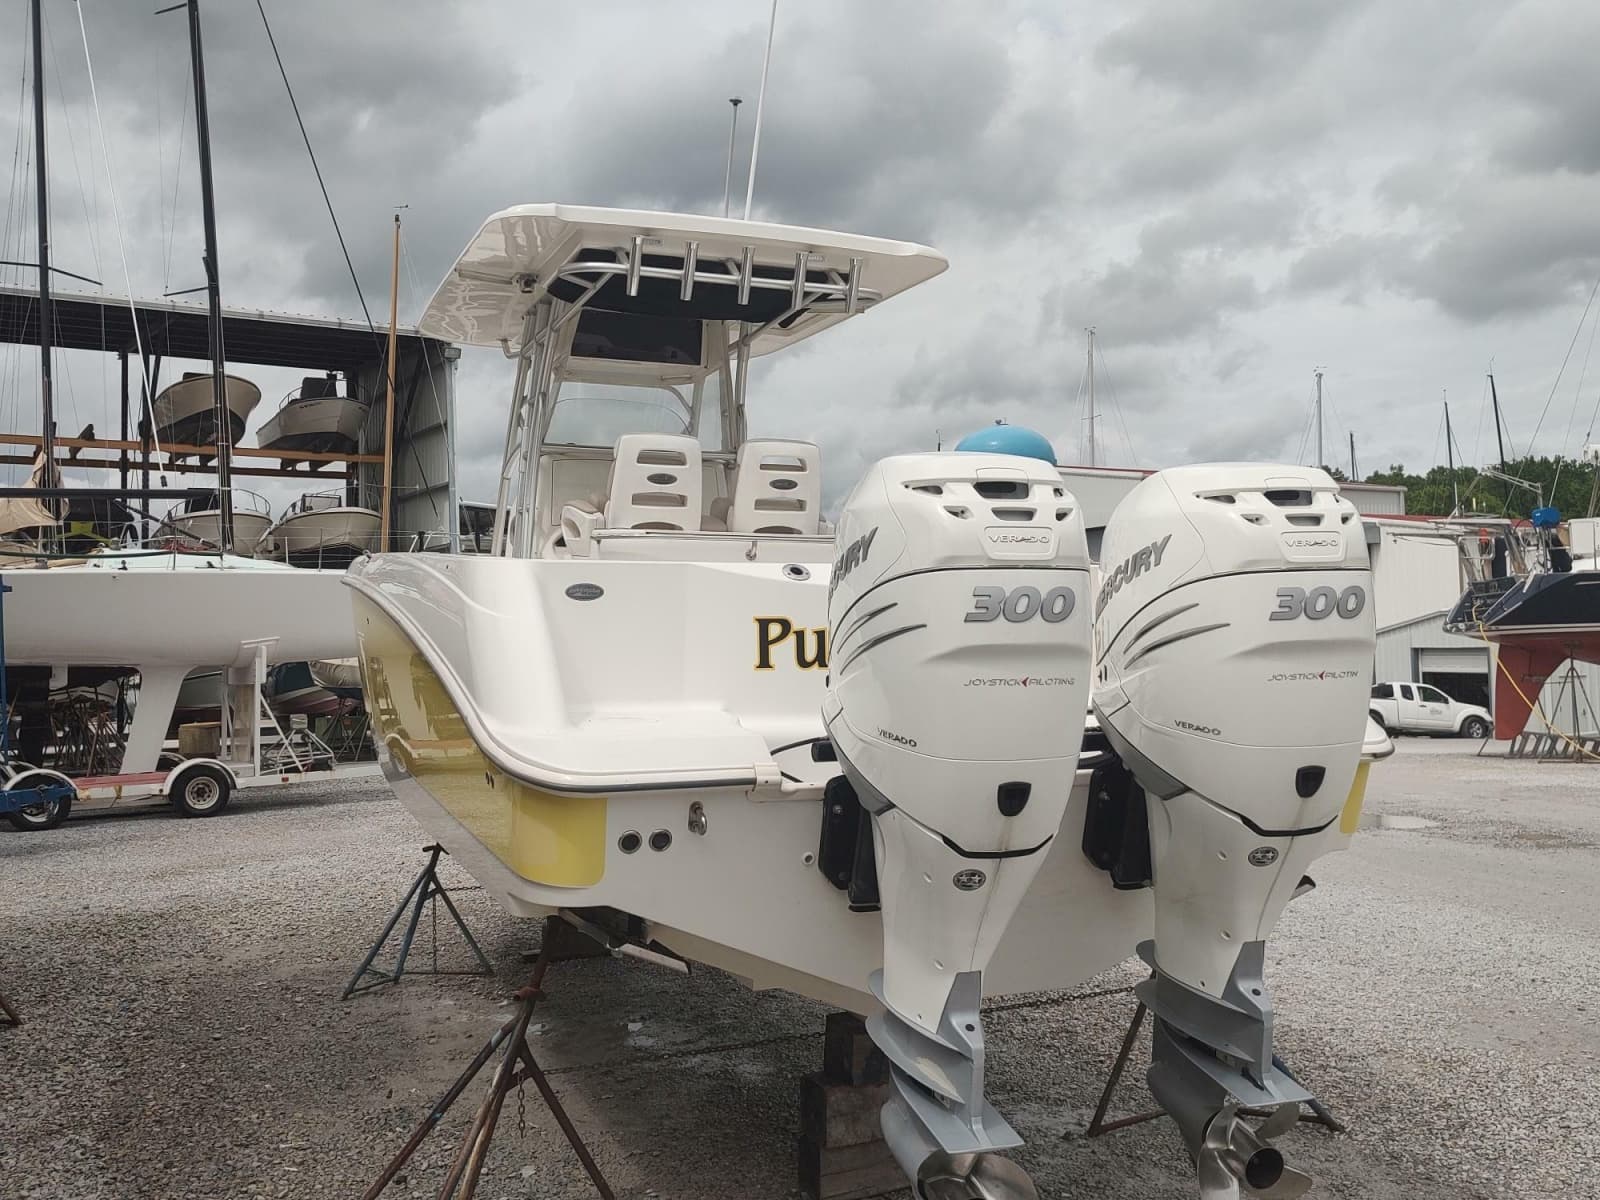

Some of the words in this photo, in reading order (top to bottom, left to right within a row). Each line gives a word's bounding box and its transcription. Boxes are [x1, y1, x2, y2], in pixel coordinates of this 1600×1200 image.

[987, 534, 1050, 544] VERADO
[1284, 539, 1339, 548] VERADO
[963, 585, 1076, 624] 300
[1268, 585, 1366, 622] 300
[752, 615, 829, 672] Pu
[962, 677, 1021, 687] JOYSTICK
[1266, 672, 1319, 682] JOYSTICK
[1174, 719, 1221, 736] VERADO
[877, 727, 917, 748] VERADO
